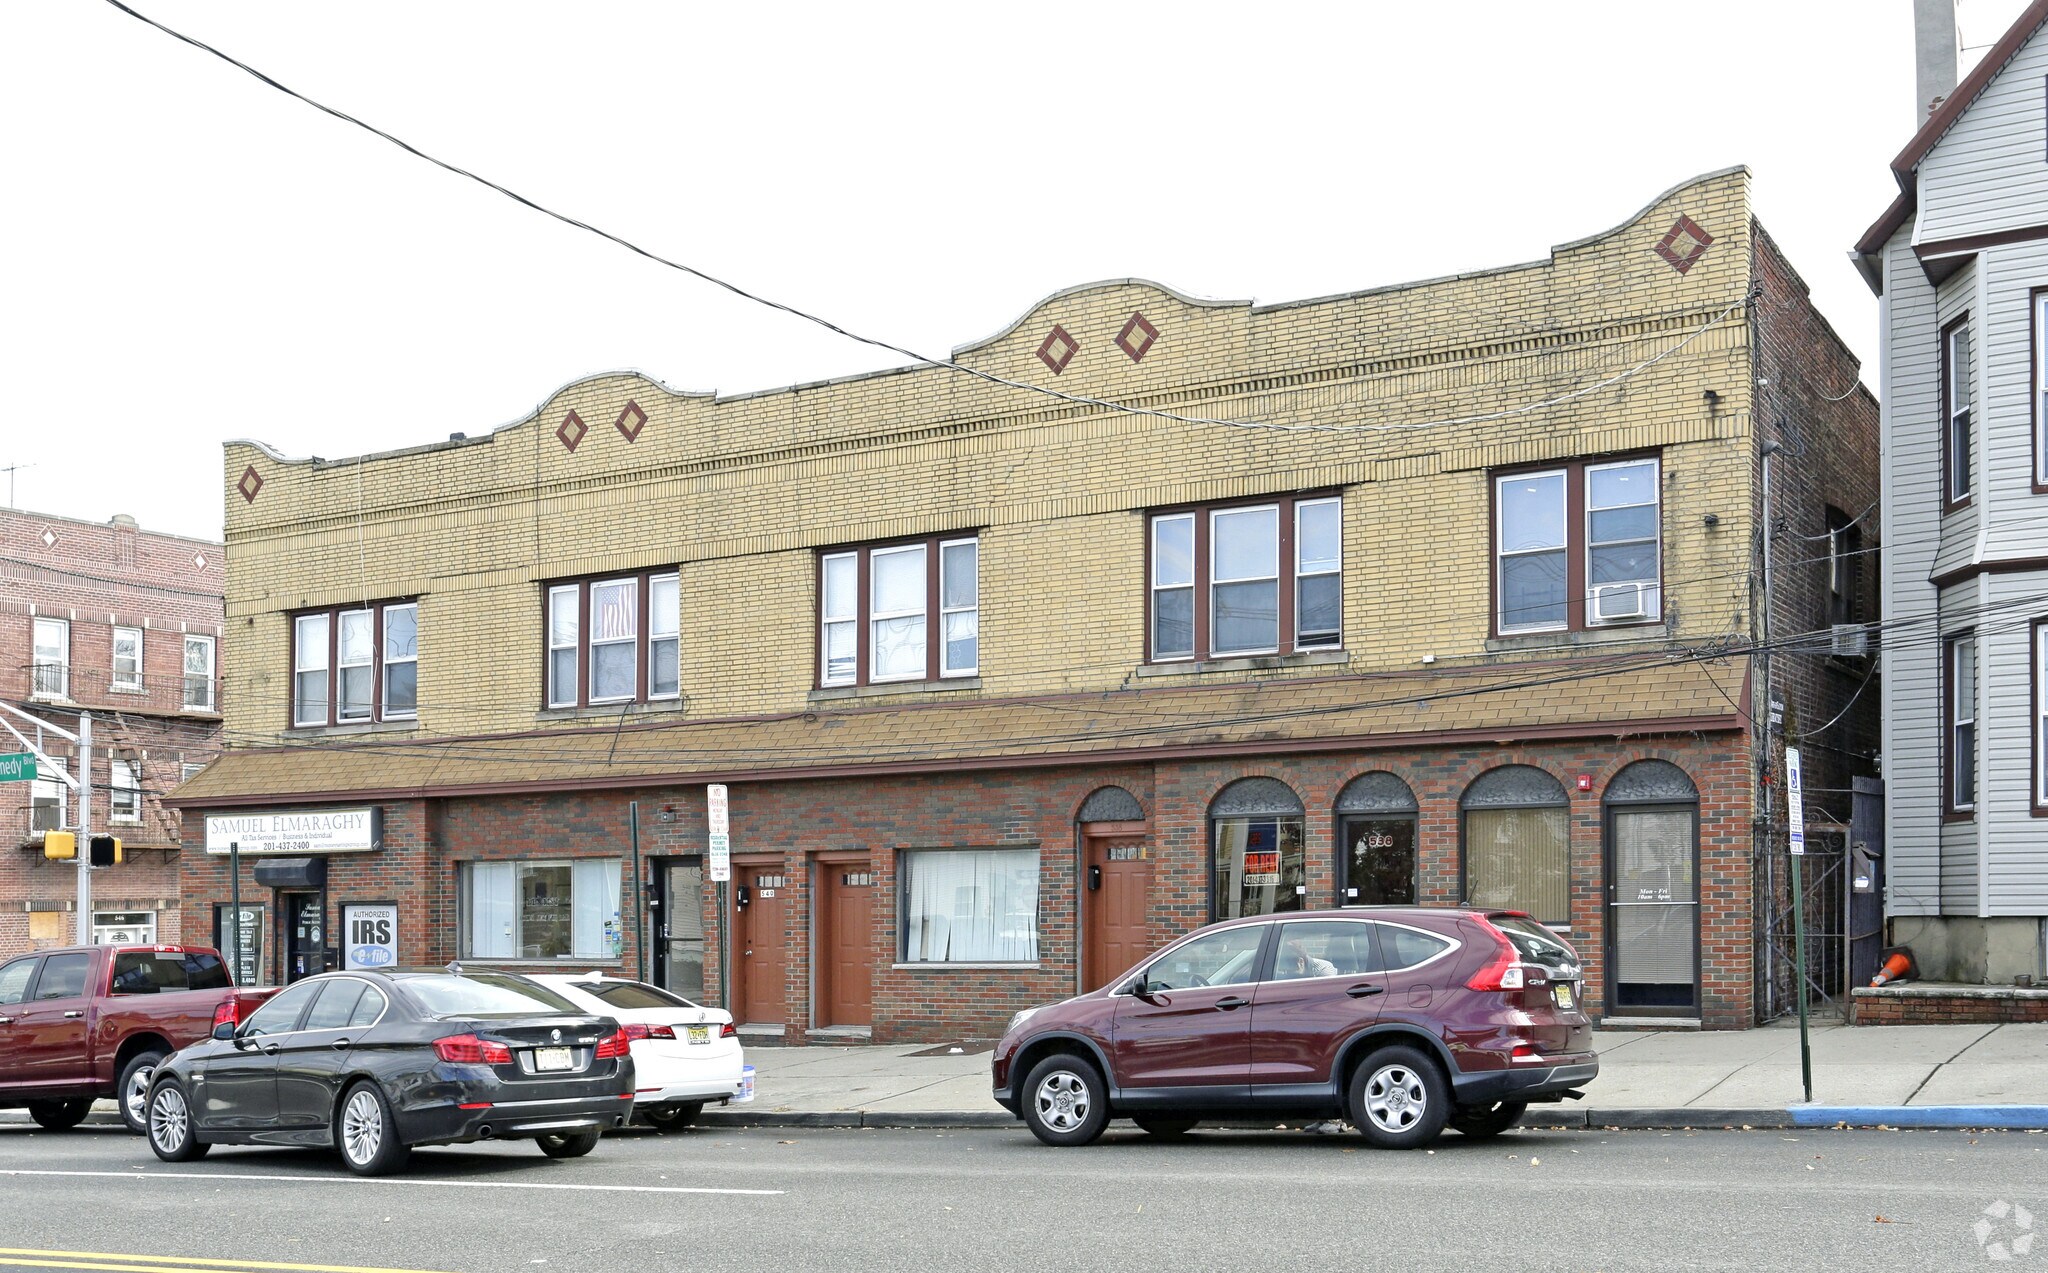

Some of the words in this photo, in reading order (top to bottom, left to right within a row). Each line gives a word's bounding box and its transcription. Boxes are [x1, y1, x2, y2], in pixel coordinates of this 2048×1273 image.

[23, 755, 35, 765] Blvd
[713, 788, 721, 797] NO
[709, 798, 727, 807] PARKING
[211, 818, 266, 834] SAMUEL
[272, 814, 364, 832] ELMARAGHY
[282, 832, 304, 840] Business
[263, 841, 310, 851] 201-437-2400
[1368, 835, 1394, 848] 538
[1245, 854, 1259, 873] FOR
[1260, 853, 1279, 873] RENT
[352, 919, 391, 945] IRS
